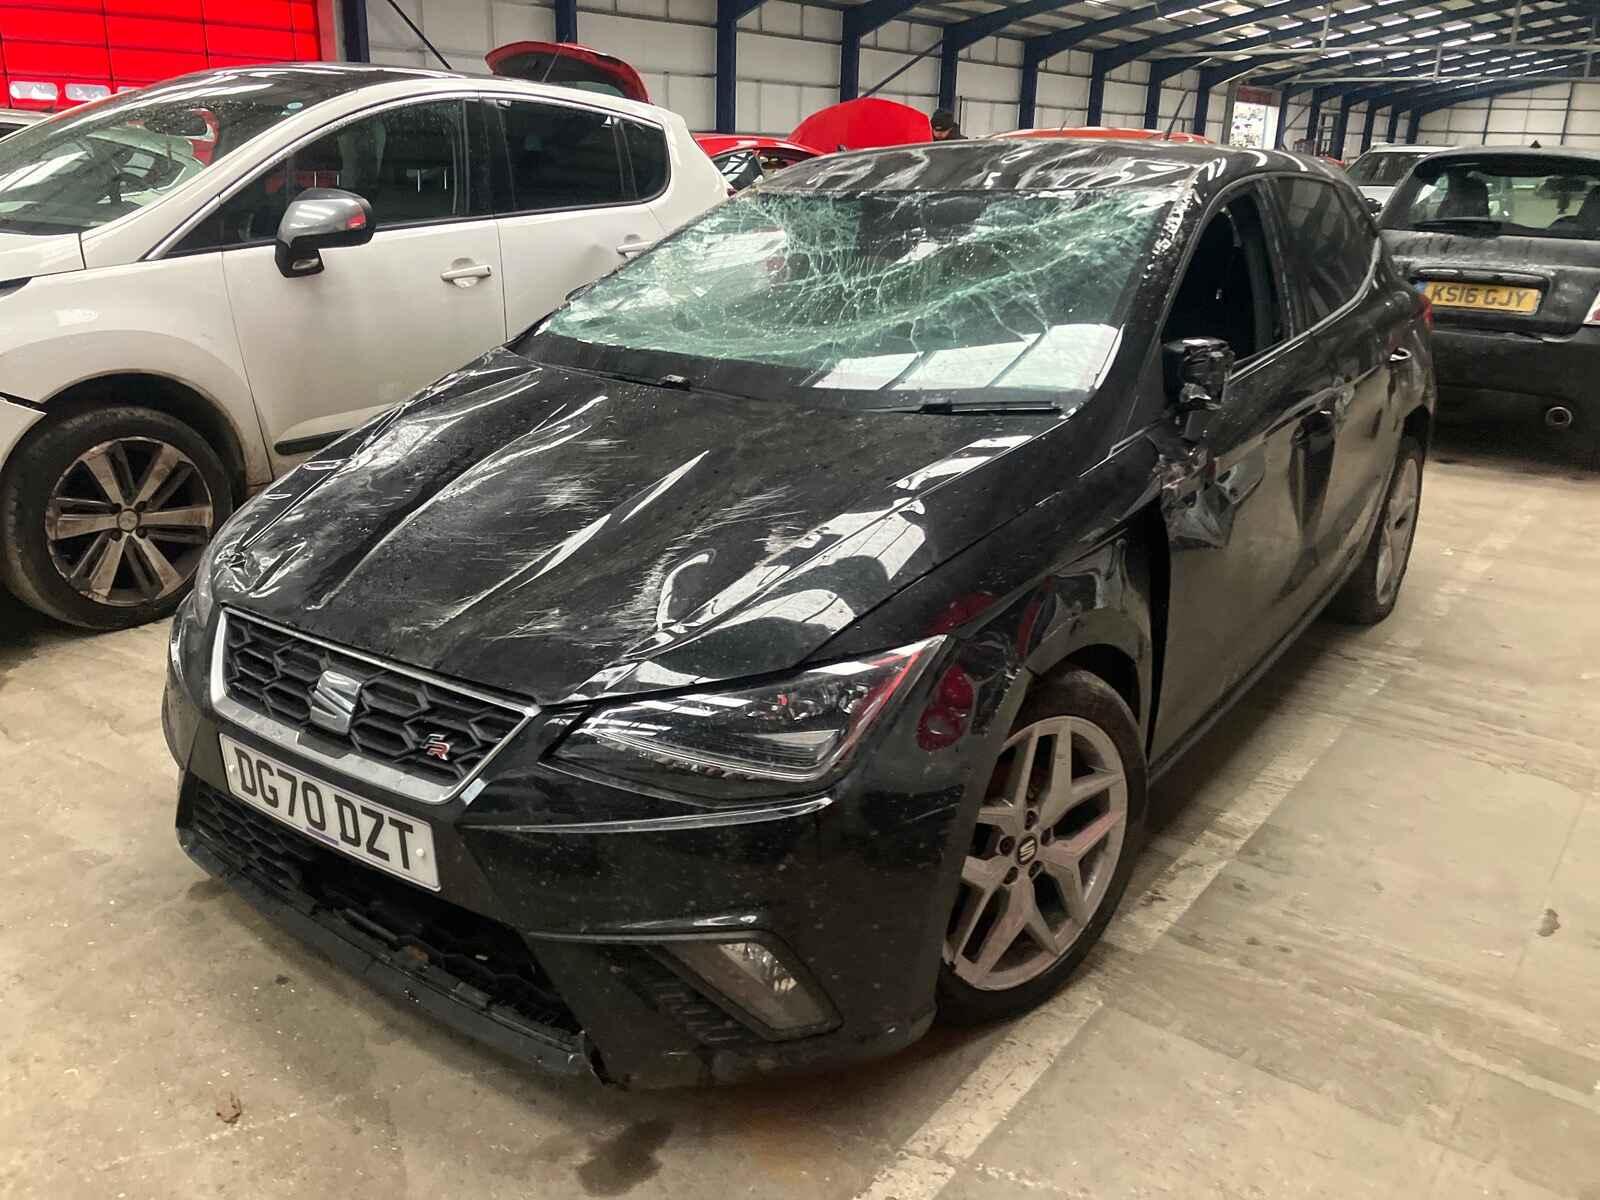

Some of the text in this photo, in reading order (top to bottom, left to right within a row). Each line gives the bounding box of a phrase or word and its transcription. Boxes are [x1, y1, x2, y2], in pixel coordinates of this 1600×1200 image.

[1431, 286, 1528, 308] KS16 GJY
[233, 746, 414, 871] DG70 DZT
